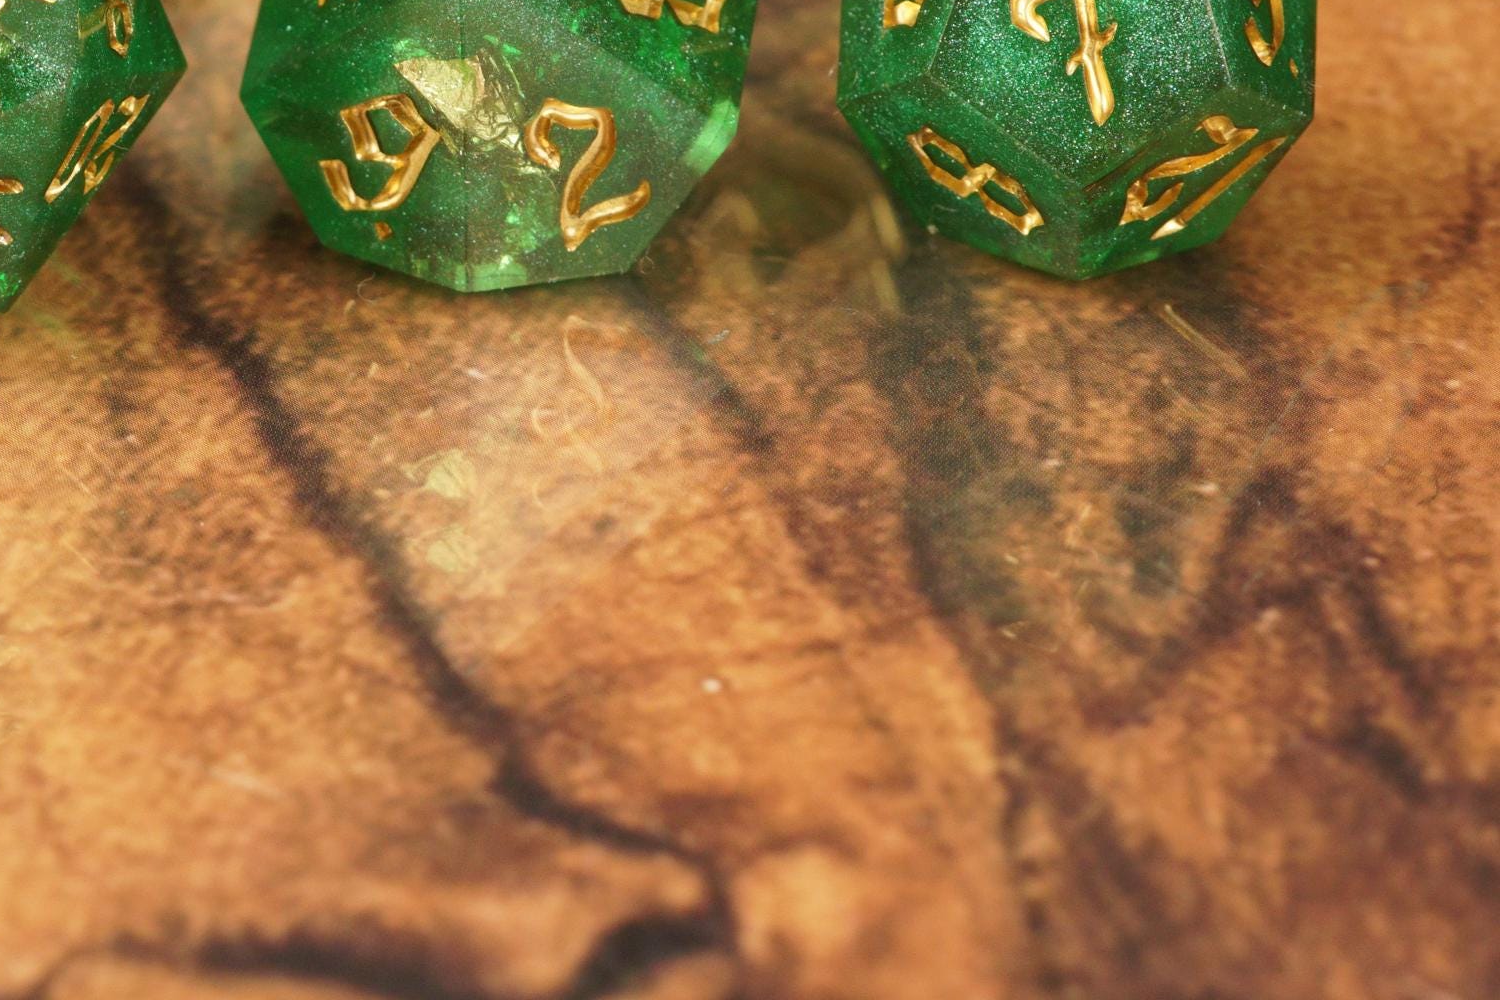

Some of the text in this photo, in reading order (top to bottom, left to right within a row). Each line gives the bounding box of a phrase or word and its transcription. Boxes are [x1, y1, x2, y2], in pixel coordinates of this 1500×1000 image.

[524, 97, 650, 251] 2
[906, 125, 1046, 236] 8
[1118, 114, 1289, 241] 12
